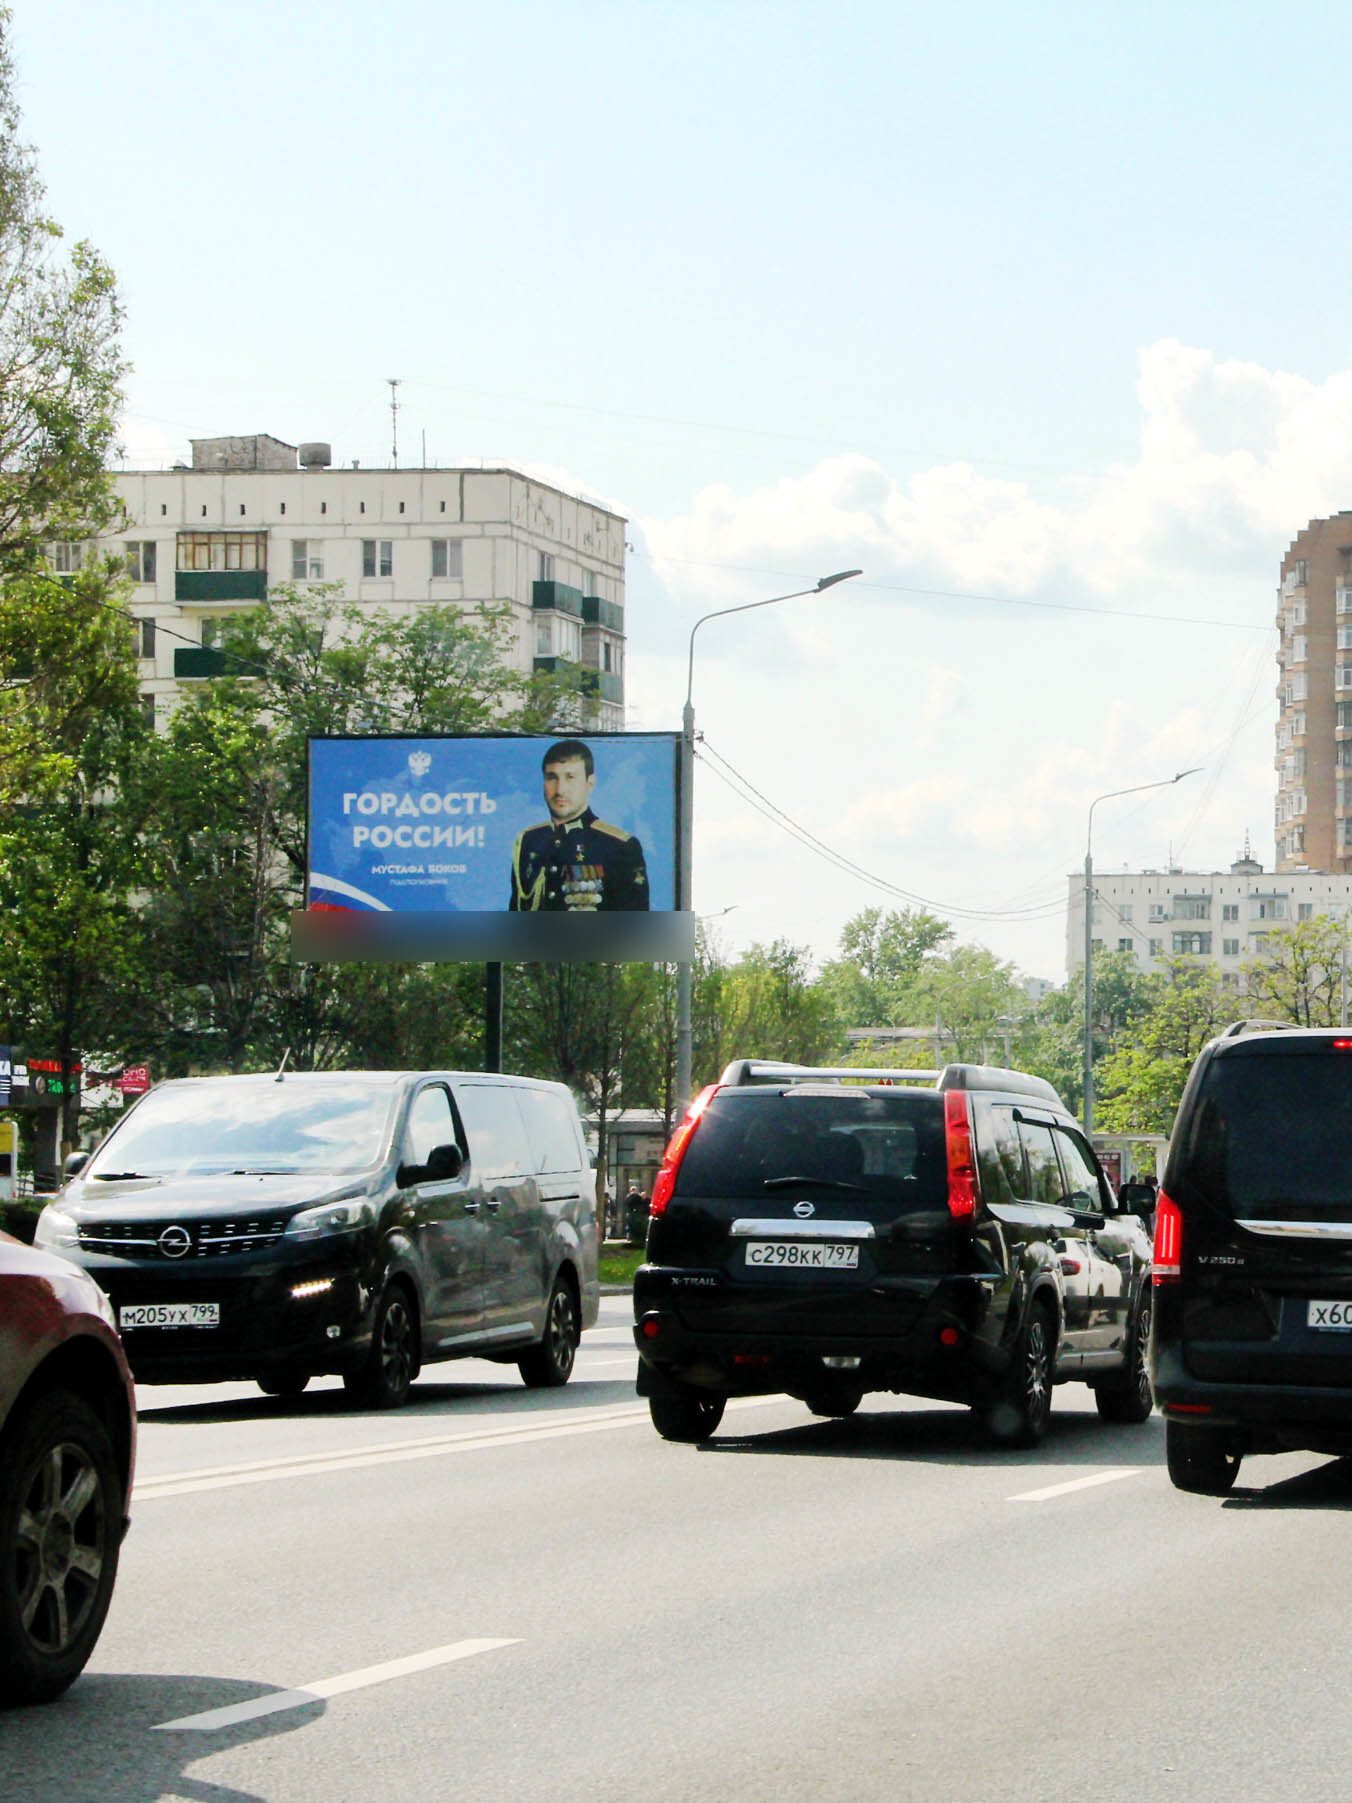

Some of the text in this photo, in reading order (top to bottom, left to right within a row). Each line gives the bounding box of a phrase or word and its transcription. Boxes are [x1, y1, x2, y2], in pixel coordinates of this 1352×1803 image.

[342, 792, 497, 818] ГОРДОСТЬ
[352, 825, 486, 849] РОССИИ!
[751, 1245, 855, 1265] С298КК 797
[671, 1277, 719, 1286] X-TRAIL
[124, 1305, 215, 1325] М205УХ 799
